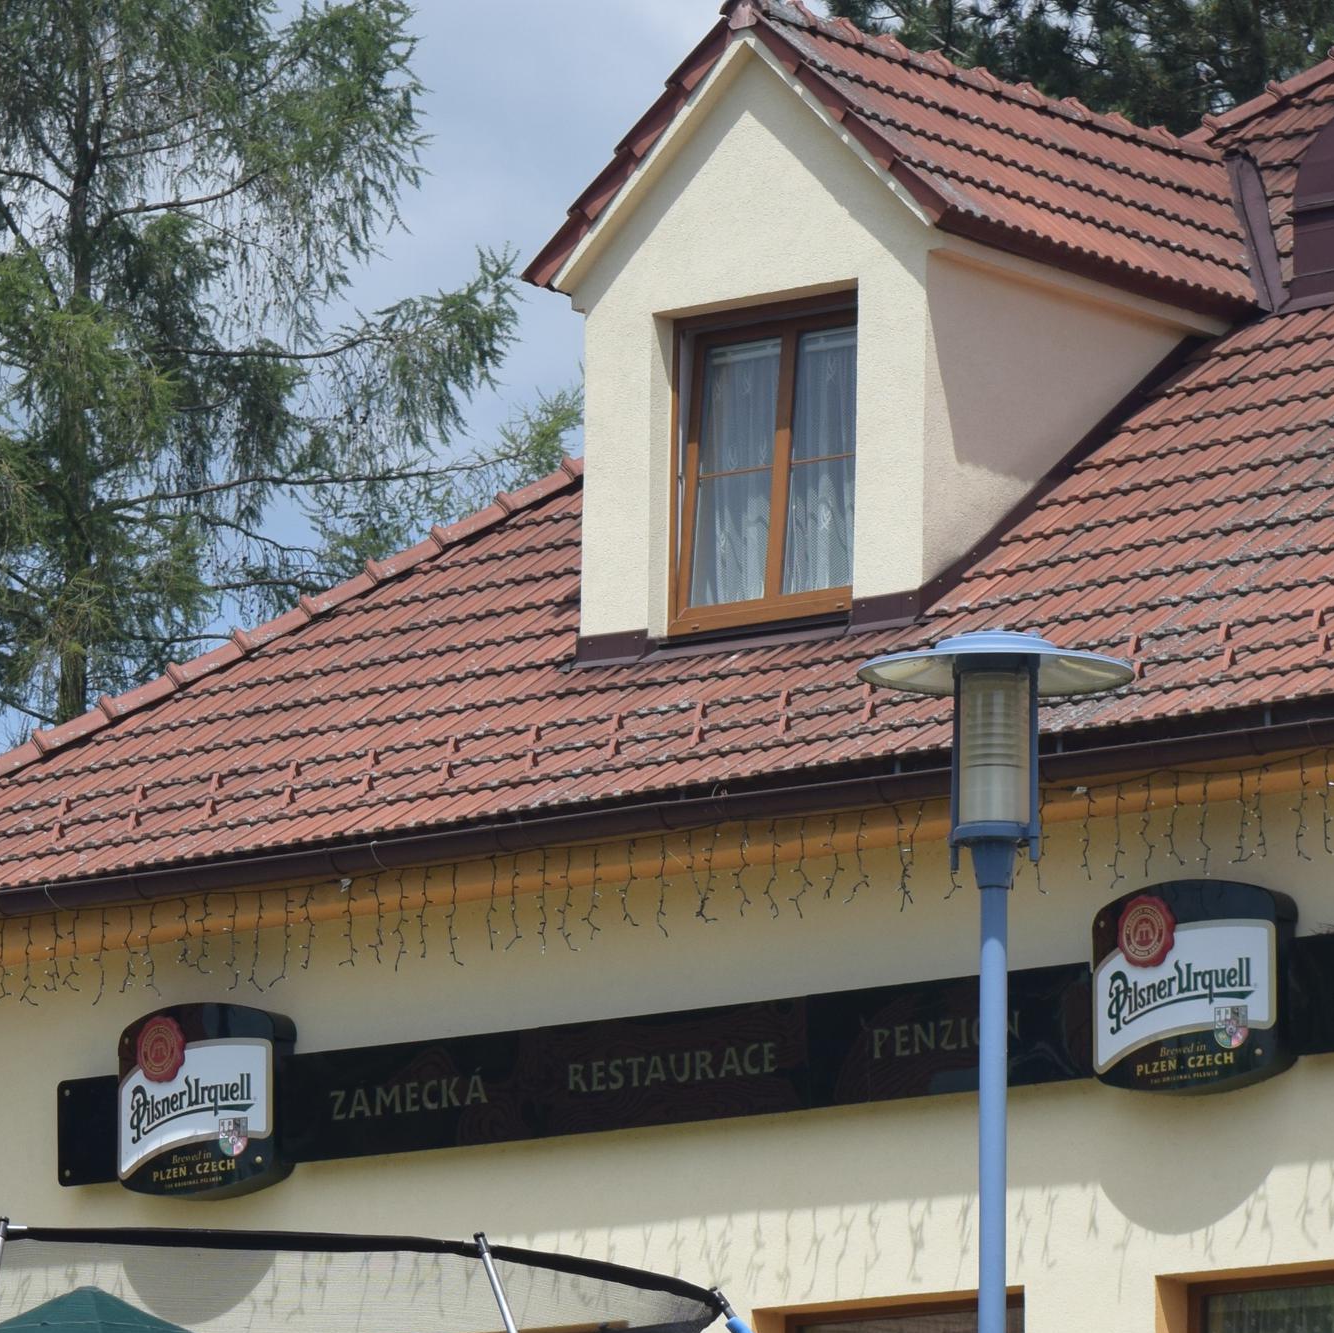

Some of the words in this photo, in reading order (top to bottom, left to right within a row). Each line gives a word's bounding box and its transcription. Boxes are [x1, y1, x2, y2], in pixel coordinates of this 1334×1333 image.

[1107, 970, 1176, 1035] Pilsner
[1174, 957, 1251, 1004] Urquell
[1195, 1042, 1206, 1053] in
[568, 1042, 778, 1092] RESTAURACE
[1187, 1052, 1234, 1068] CZECH
[130, 1085, 188, 1144] Pilsner
[185, 1073, 251, 1116] Urquell
[203, 1150, 212, 1160] in
[195, 1159, 236, 1175] CZECH
